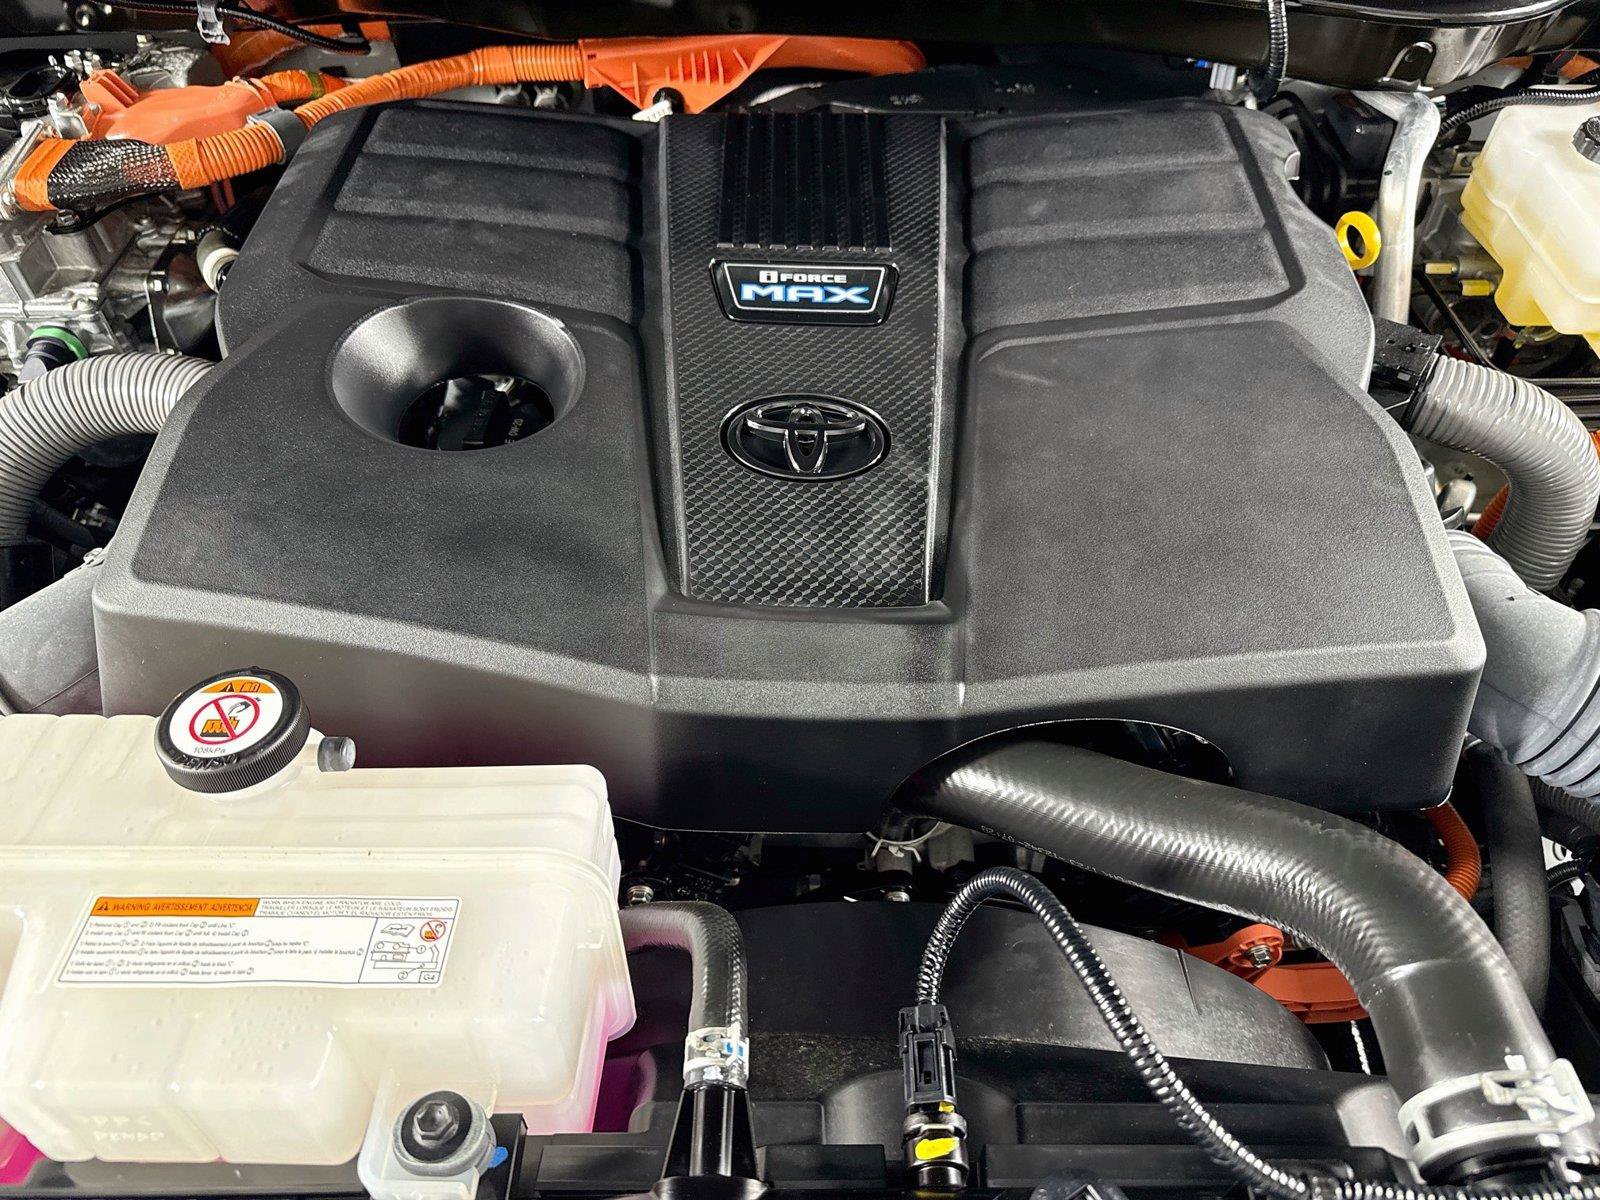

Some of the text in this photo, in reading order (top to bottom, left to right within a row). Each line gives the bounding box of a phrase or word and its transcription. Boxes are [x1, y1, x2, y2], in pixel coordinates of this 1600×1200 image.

[740, 284, 870, 304] MAX
[178, 754, 239, 771] DENSO
[113, 903, 150, 911] WARNING
[153, 903, 208, 911] AVERTISSEMENT
